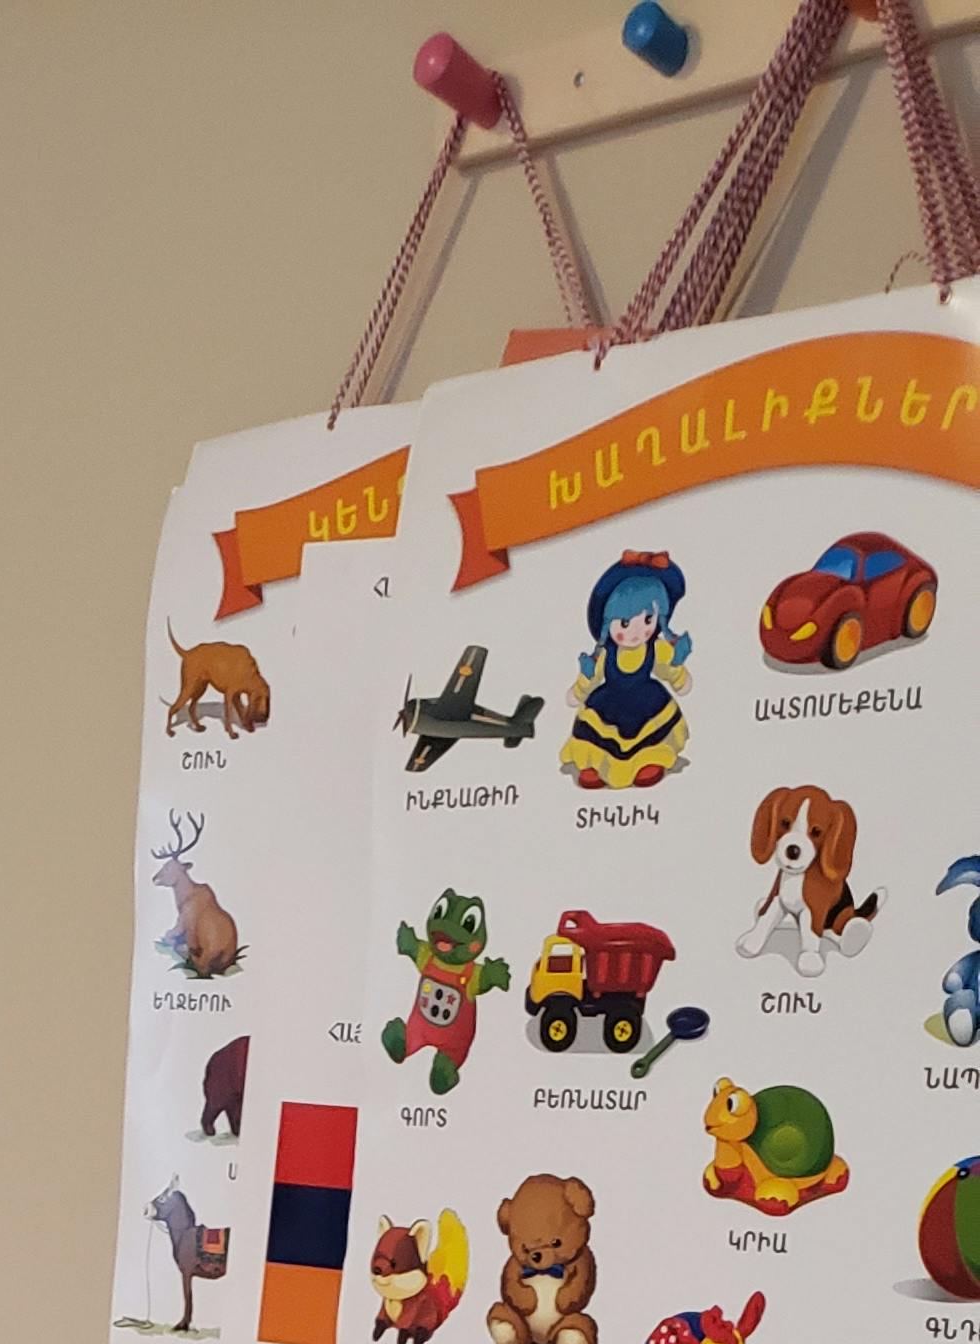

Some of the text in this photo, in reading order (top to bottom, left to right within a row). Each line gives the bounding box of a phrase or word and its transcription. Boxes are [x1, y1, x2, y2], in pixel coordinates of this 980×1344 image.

[549, 376, 980, 511] ԽԱՂԱԼԻՔՆԵՐ
[308, 474, 406, 542] ԿԵՆ
[755, 686, 922, 721] ԱՎՏՈՄԵՔԵՆԱ
[182, 751, 227, 770] ՇՈՒՆ
[406, 784, 519, 811] ԻՆՔՆԱԹԻՌ
[575, 804, 660, 829] ՏԻԿՆԻԿ
[153, 991, 232, 1012] ԵՂՋԵՐՈՒ
[761, 992, 822, 1014] ՇՈՒՆ
[534, 1088, 647, 1110] ԲԵՌՆԱՏԱՐ
[400, 1107, 447, 1128] ԳՈՐՏ
[728, 1230, 788, 1254] ԿՐԻԱ
[926, 1317, 980, 1341] ԳՆԴ
